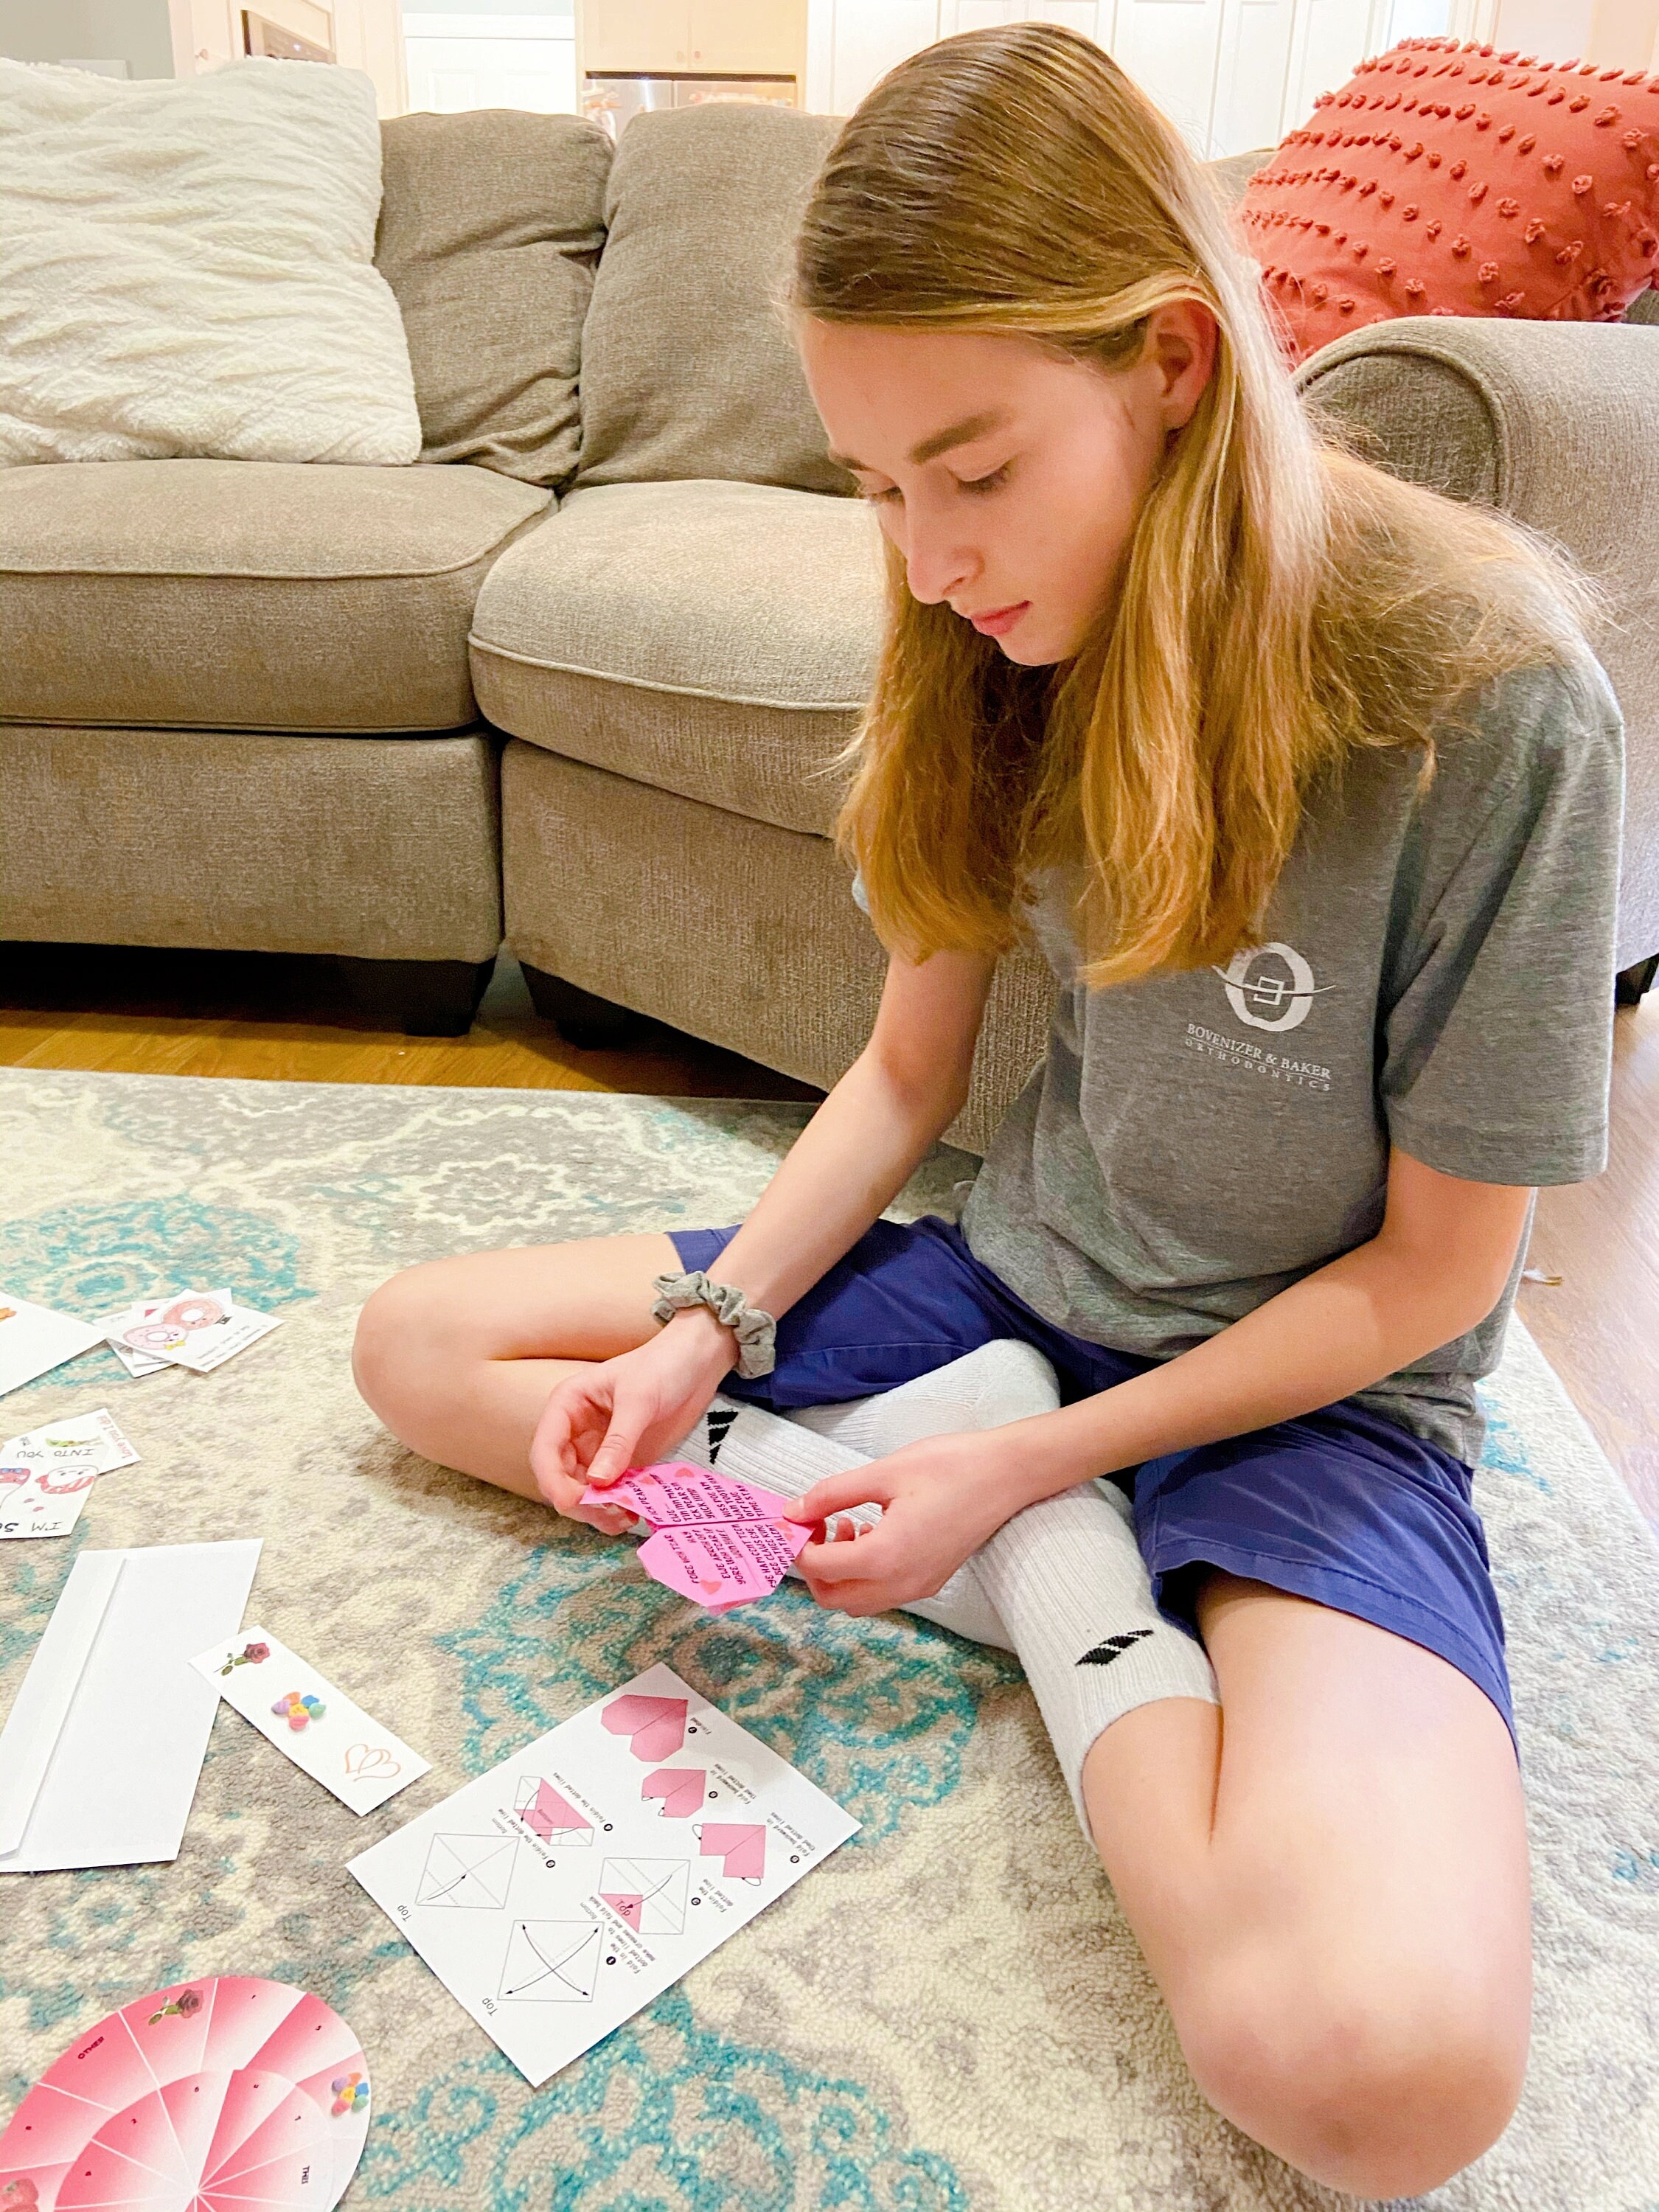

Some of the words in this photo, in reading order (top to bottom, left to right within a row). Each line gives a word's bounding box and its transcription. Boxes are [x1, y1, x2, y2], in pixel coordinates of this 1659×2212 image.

[1187, 1023, 1262, 1060] BOVENIZER
[1265, 1053, 1278, 1065] &
[1281, 1058, 1332, 1079] BAKER
[1185, 1038, 1330, 1091] ORTHODONTICS
[17, 1450, 44, 1458] YOU
[54, 1448, 95, 1457] INTO
[678, 1492, 695, 1509] PEAR
[713, 1485, 733, 1504] TOOTH
[735, 1485, 753, 1500] STAY
[691, 1509, 703, 1520] ICK
[748, 1502, 765, 1517] TIME
[0, 1522, 19, 1532] S
[31, 1521, 63, 1531] I'M
[754, 1524, 770, 1538] KING
[754, 1540, 775, 1560] CLAWS
[715, 1564, 731, 1579] EWE
[729, 1567, 746, 1585] YORE
[397, 1905, 411, 1922] Top
[615, 1900, 631, 1917] Top
[482, 1998, 498, 2016] Top
